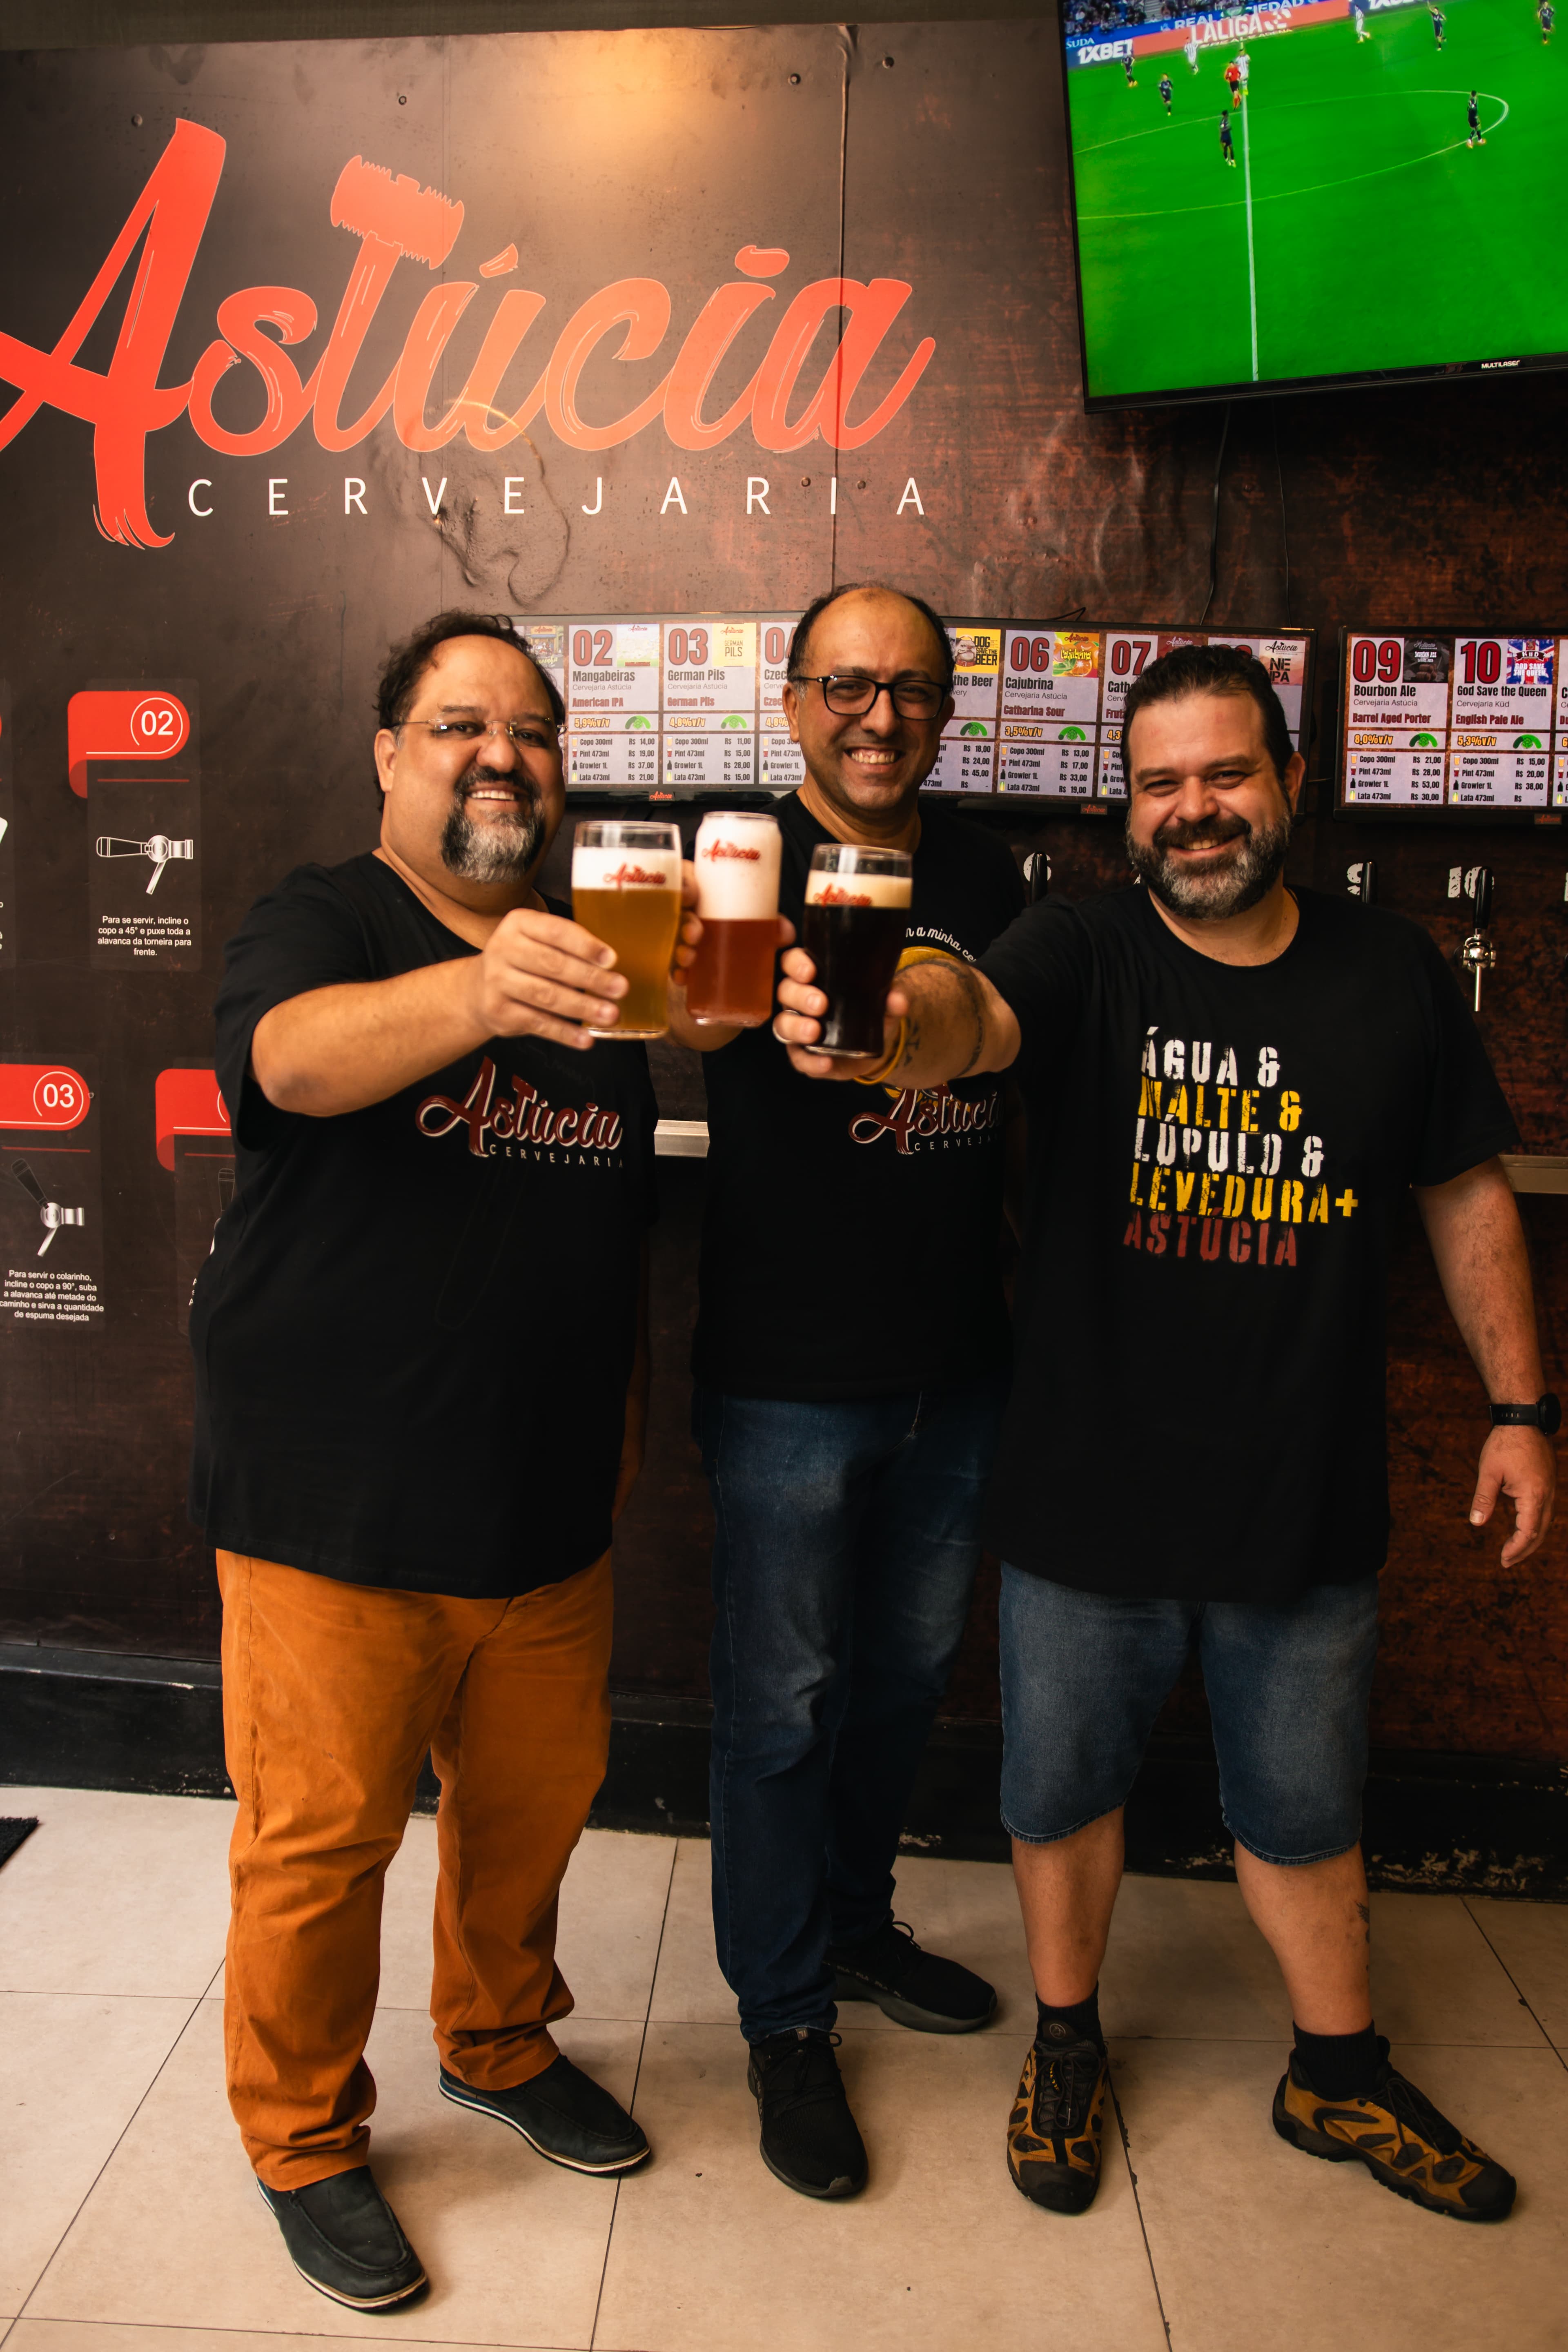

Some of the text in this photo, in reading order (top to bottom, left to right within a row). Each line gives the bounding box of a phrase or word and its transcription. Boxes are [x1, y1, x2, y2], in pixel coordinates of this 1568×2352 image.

[1174, 14, 1214, 29] REAL
[1190, 13, 1263, 43] LALIGA
[1078, 40, 1133, 64] 1XBET
[0, 118, 936, 548] Astúcia
[1481, 360, 1520, 369] MULTILASER
[188, 476, 926, 517] CERVEJARIA
[669, 628, 708, 665] 03
[974, 636, 991, 647] DOG
[573, 630, 612, 666] 02
[725, 647, 742, 657] PILS
[1011, 636, 1049, 672] 06
[976, 655, 997, 666] BEER
[1060, 649, 1091, 660] Cajubrina
[1111, 640, 1151, 675] 07
[1270, 657, 1291, 671] NE
[1353, 639, 1401, 683] 09
[1461, 641, 1501, 684] 10
[573, 670, 635, 685] Mangabeiras
[668, 670, 725, 681] German Pils
[953, 675, 993, 687] the Beer
[1270, 670, 1290, 682] IPA
[1006, 677, 1053, 690] Cajubrina
[1005, 691, 1040, 699] Cervejaria
[1354, 685, 1416, 697] Bourbon Ale
[1457, 686, 1546, 697] God Save the Queen
[572, 697, 624, 707] American IPA
[668, 697, 714, 706] German Pils
[1457, 700, 1492, 708] Cervejaria
[1004, 705, 1065, 717] Catharina Sour
[141, 710, 173, 735] 02
[575, 718, 610, 728] 5,9%v/v
[670, 717, 705, 728] 4,8%v/v
[1353, 713, 1431, 724] Barrel Aged Porter
[1456, 714, 1524, 725] English Pale Ale
[1005, 726, 1042, 737] 3,5%v/v
[1354, 734, 1393, 745] 8,0%v/v
[1457, 736, 1496, 747] 5,3%v/v
[1010, 747, 1024, 756] Copo
[1074, 750, 1089, 758] 13,00
[102, 915, 120, 924] Para
[916, 927, 926, 937] a
[927, 928, 961, 951] minha
[1141, 1026, 1281, 1087] ÁGUA &
[43, 1083, 74, 1108] 03
[1138, 1075, 1303, 1134] MALTE &
[1134, 1114, 1325, 1177] LÚPULO &
[490, 1144, 624, 1168] CERVEJARIA
[1123, 1207, 1297, 1267] ASTÚCIA
[9, 1270, 26, 1278] Para
[56, 1272, 91, 1282] colarinho,
[4, 1280, 27, 1288] incline
[10, 1290, 42, 1298] alavanca
[64, 1303, 104, 1312] quantidade
[56, 1313, 89, 1322] desejada
